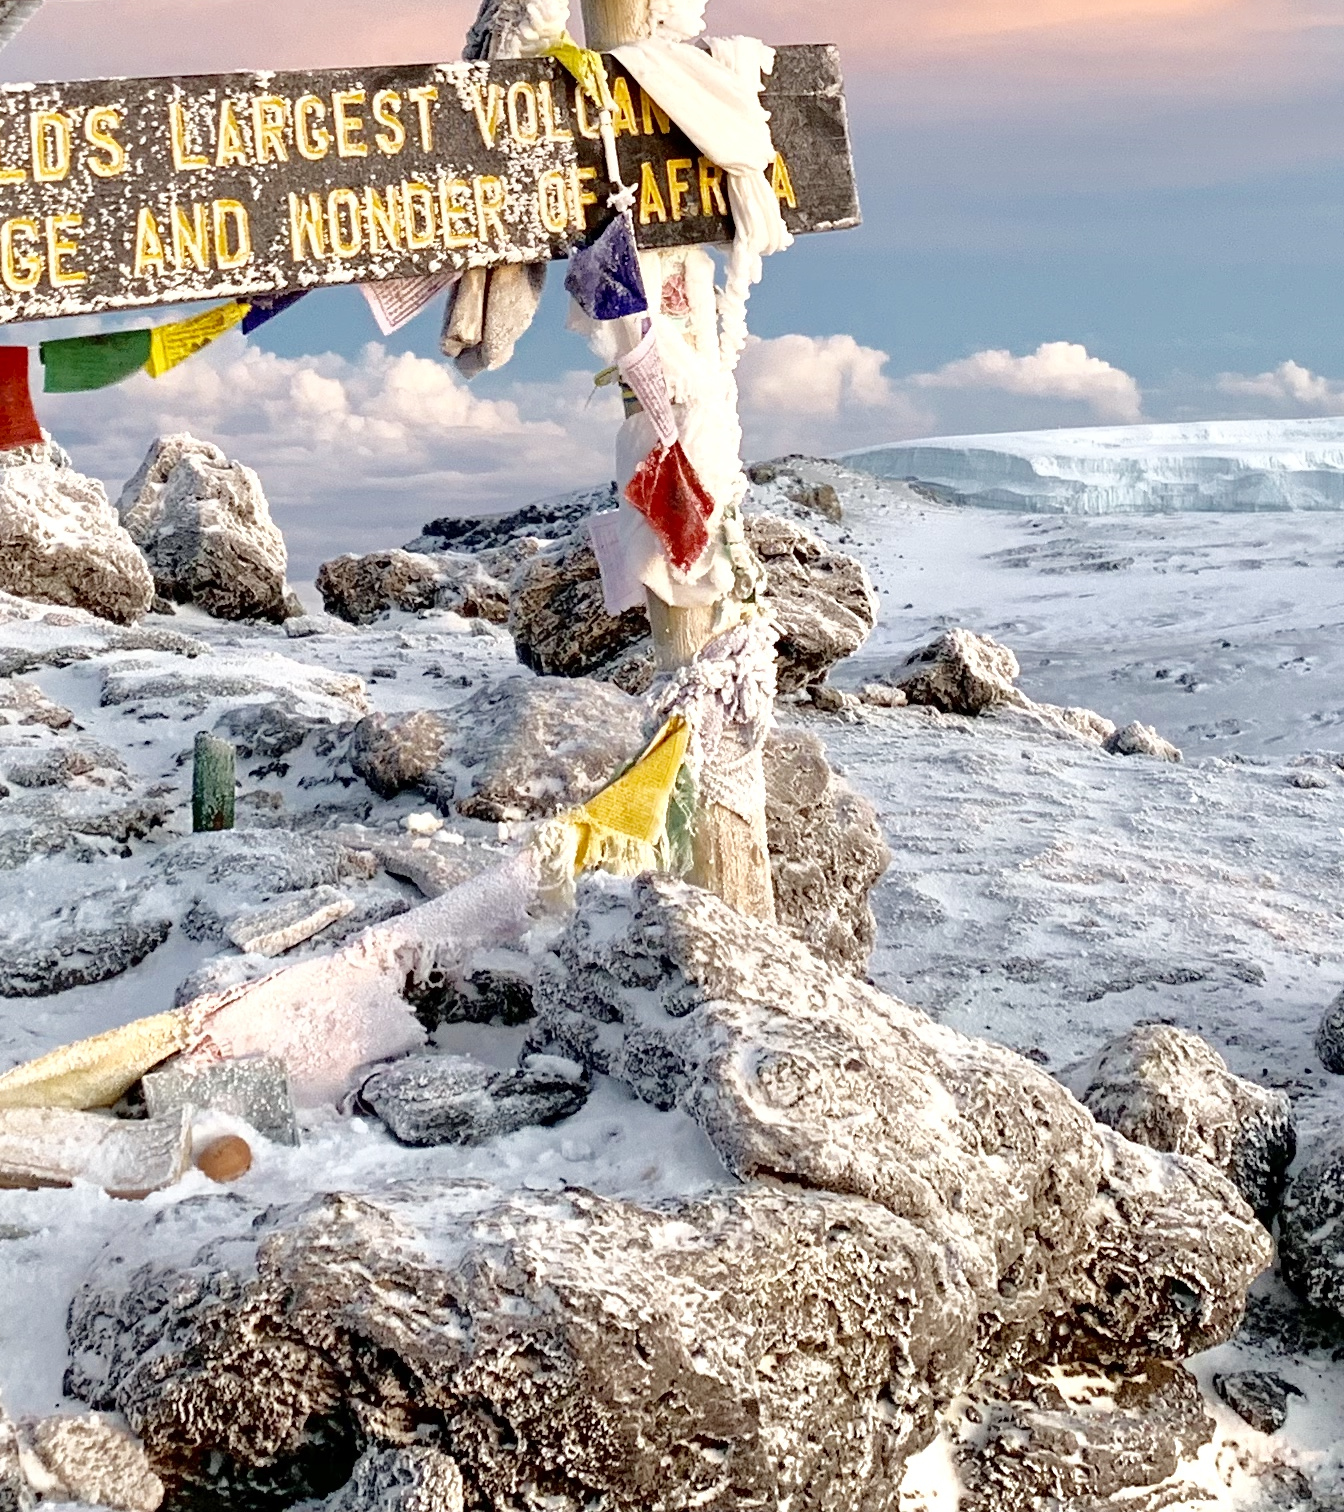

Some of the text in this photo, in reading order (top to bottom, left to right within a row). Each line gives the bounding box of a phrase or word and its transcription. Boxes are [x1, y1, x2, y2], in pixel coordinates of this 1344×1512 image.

[169, 85, 440, 173] LARGEST
[134, 198, 253, 279] AND
[289, 175, 506, 262] WONDER
[538, 166, 598, 233] OF
[638, 151, 798, 225] AFRA
